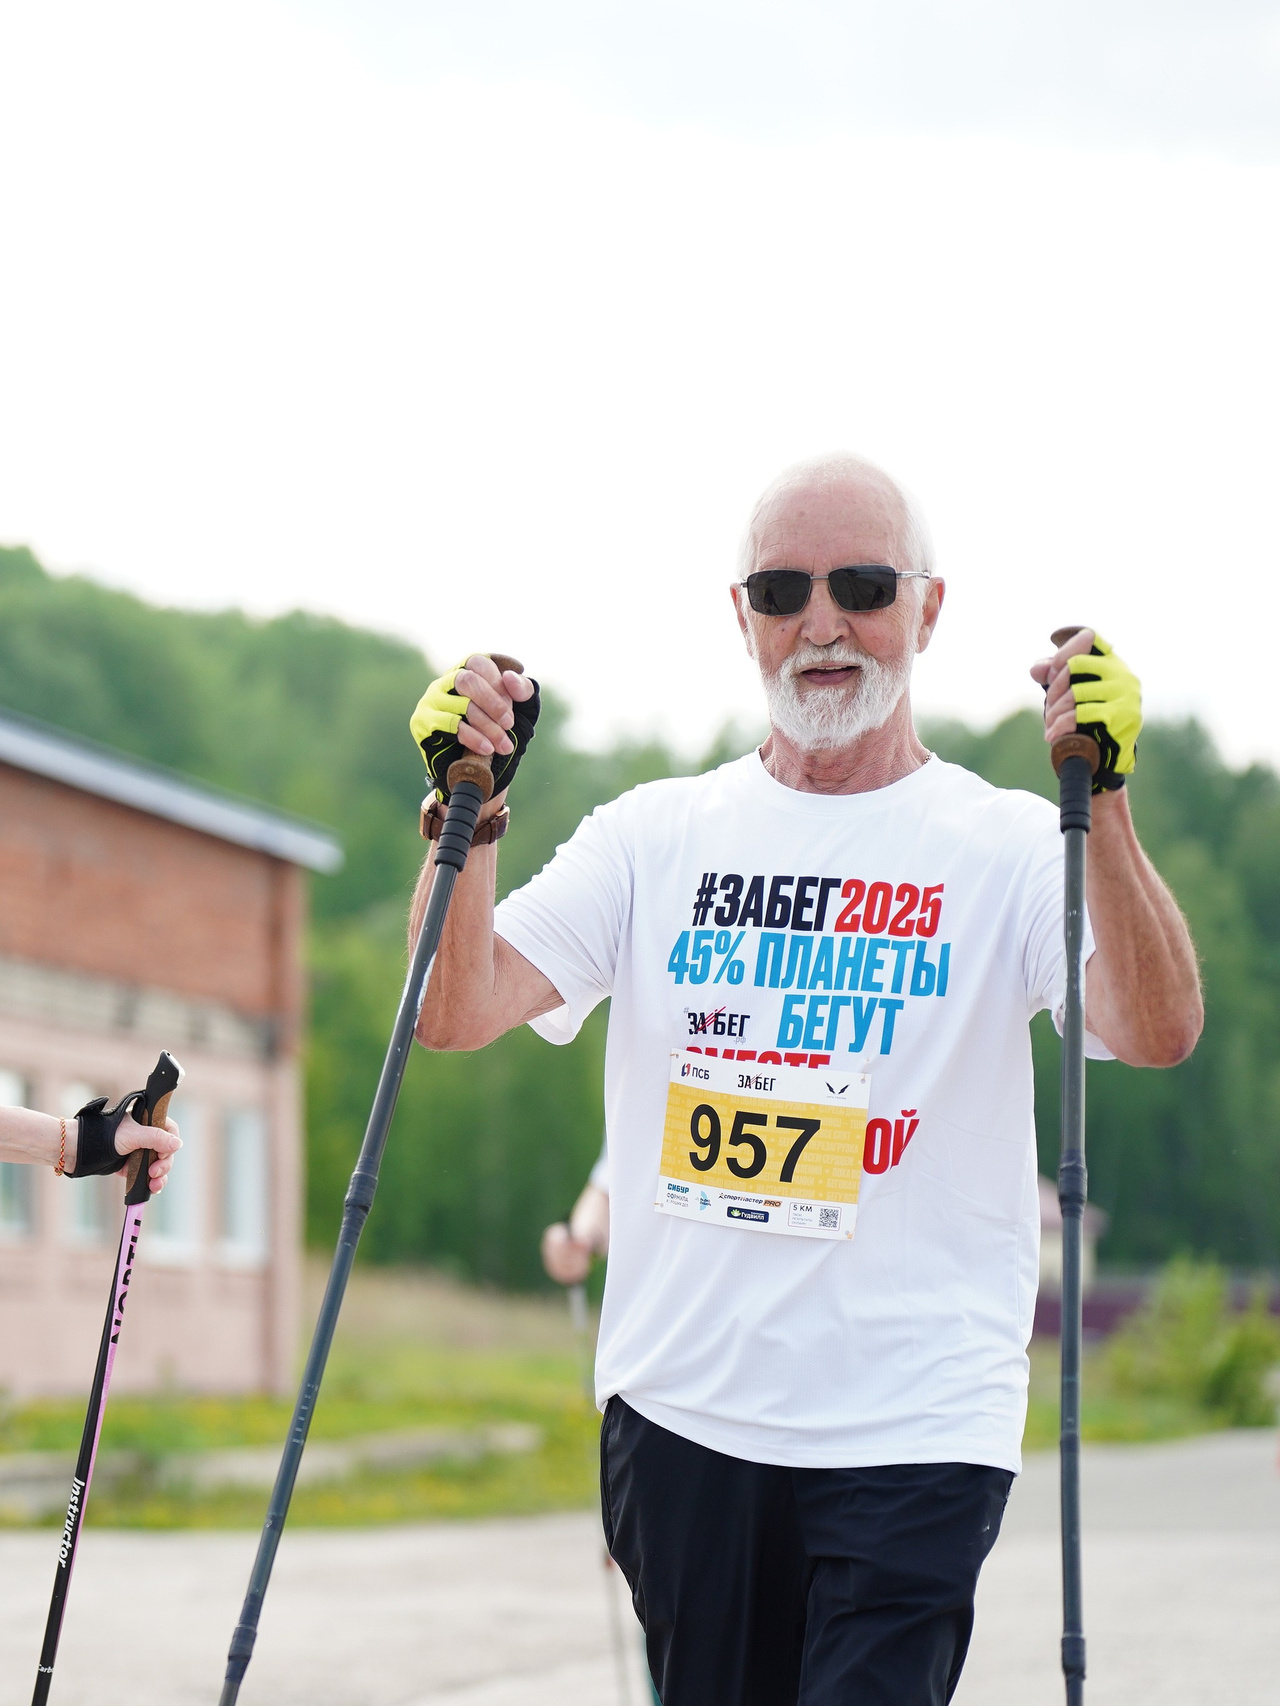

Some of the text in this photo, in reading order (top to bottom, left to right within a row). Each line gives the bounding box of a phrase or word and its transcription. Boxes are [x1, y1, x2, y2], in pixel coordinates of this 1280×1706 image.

[668, 930, 951, 997] 45% ПЛАНЕТЫ
[776, 994, 904, 1055] БЕГУТ
[692, 1067, 710, 1080] ПСБ
[689, 1104, 821, 1183] 957
[668, 1183, 689, 1194] СИБУР
[59, 1477, 85, 1568] Instructor
